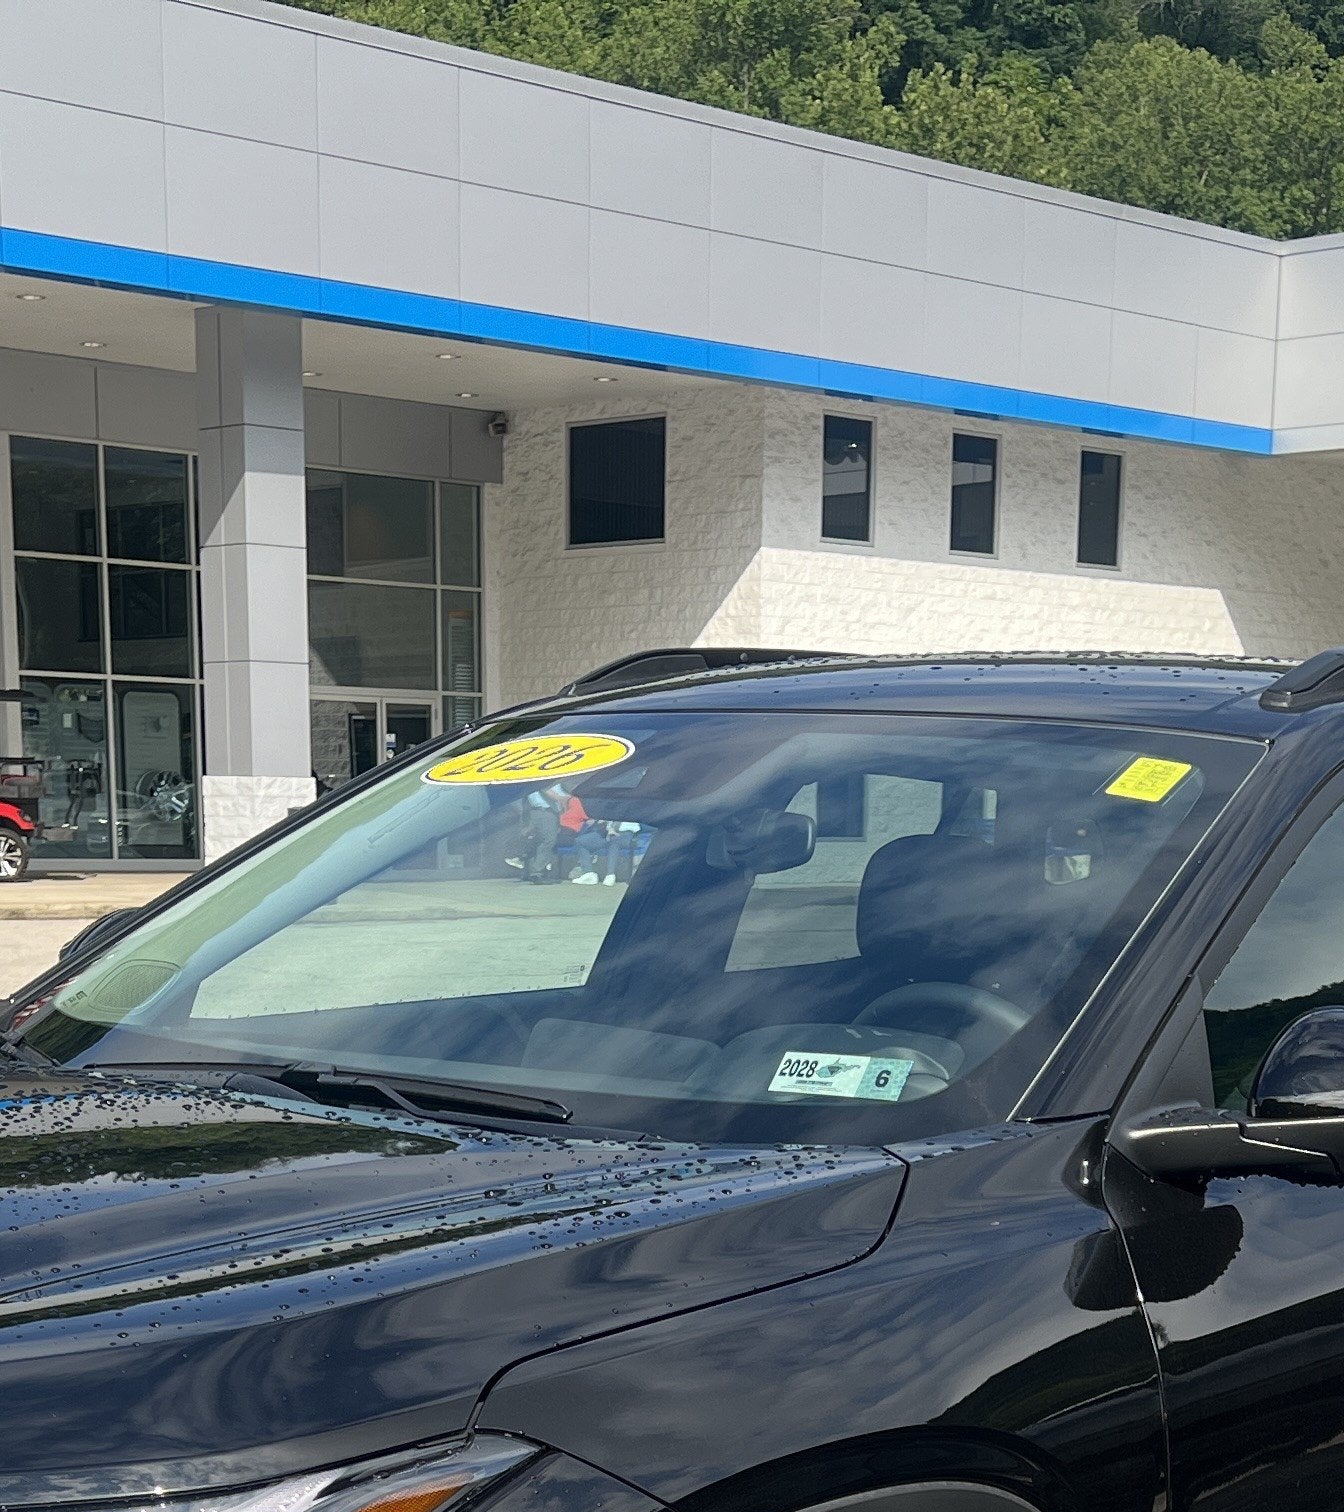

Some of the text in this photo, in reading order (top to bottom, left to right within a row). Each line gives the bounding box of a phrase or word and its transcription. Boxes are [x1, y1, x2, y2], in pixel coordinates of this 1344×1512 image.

[440, 744, 611, 777] 2026
[778, 1058, 892, 1088] 2028 6
